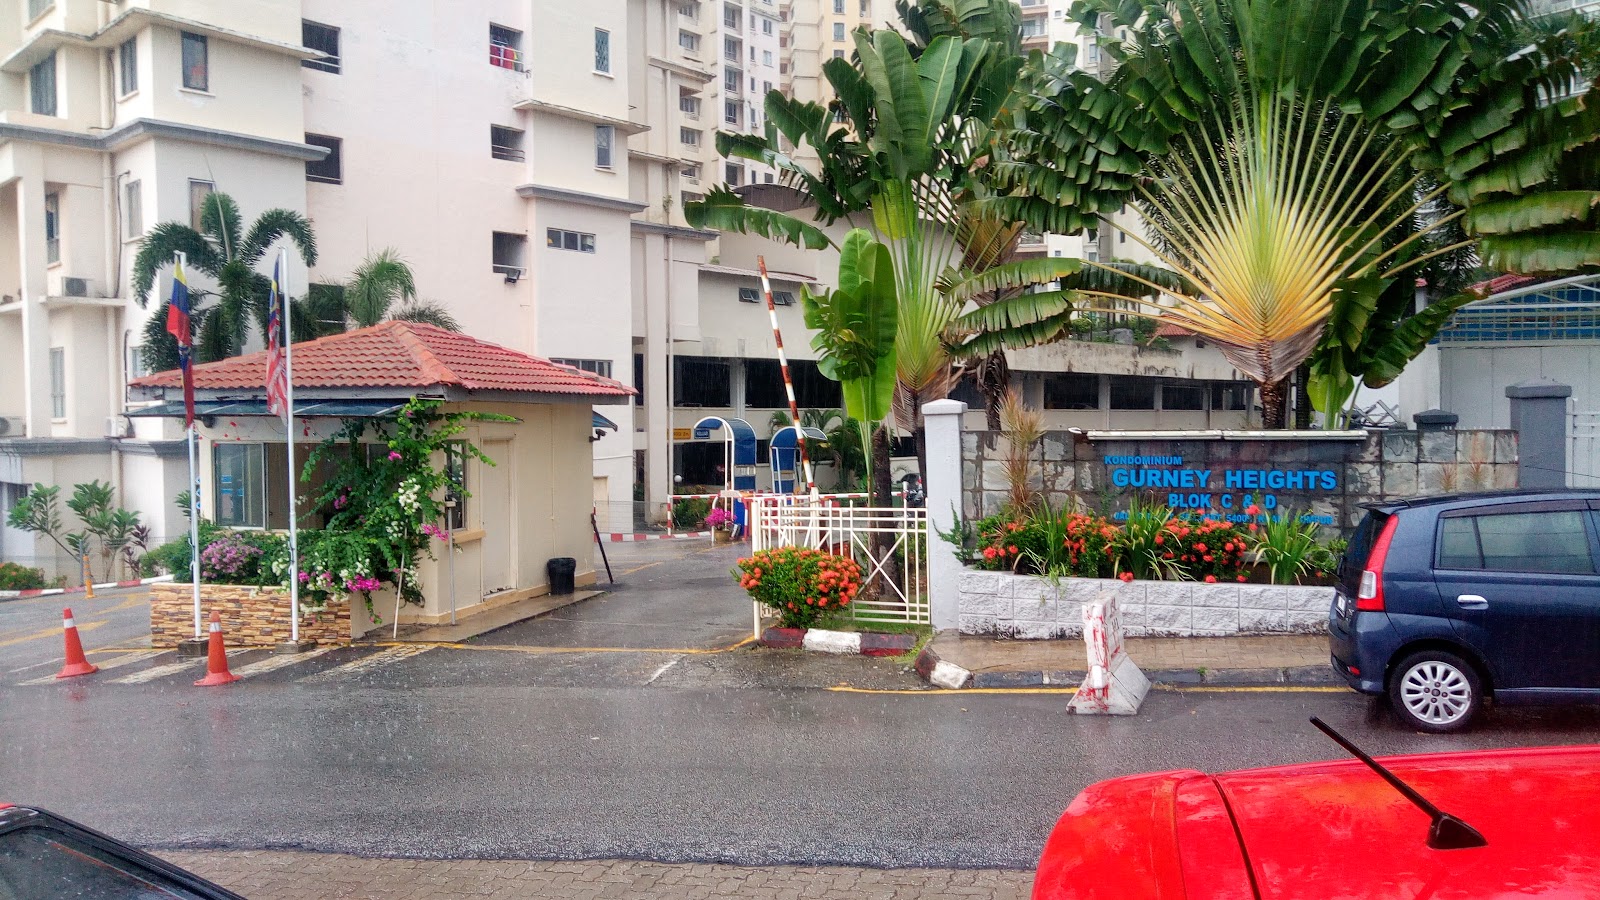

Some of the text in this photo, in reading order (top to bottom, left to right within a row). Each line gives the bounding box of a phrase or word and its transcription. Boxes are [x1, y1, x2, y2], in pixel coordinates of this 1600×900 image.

[1104, 456, 1183, 465] KONDOMINIUM
[1112, 469, 1337, 490] GURNEY HEIGHTS
[1168, 493, 1211, 508] BLOK
[1221, 494, 1232, 508] C
[1265, 495, 1277, 509] D
